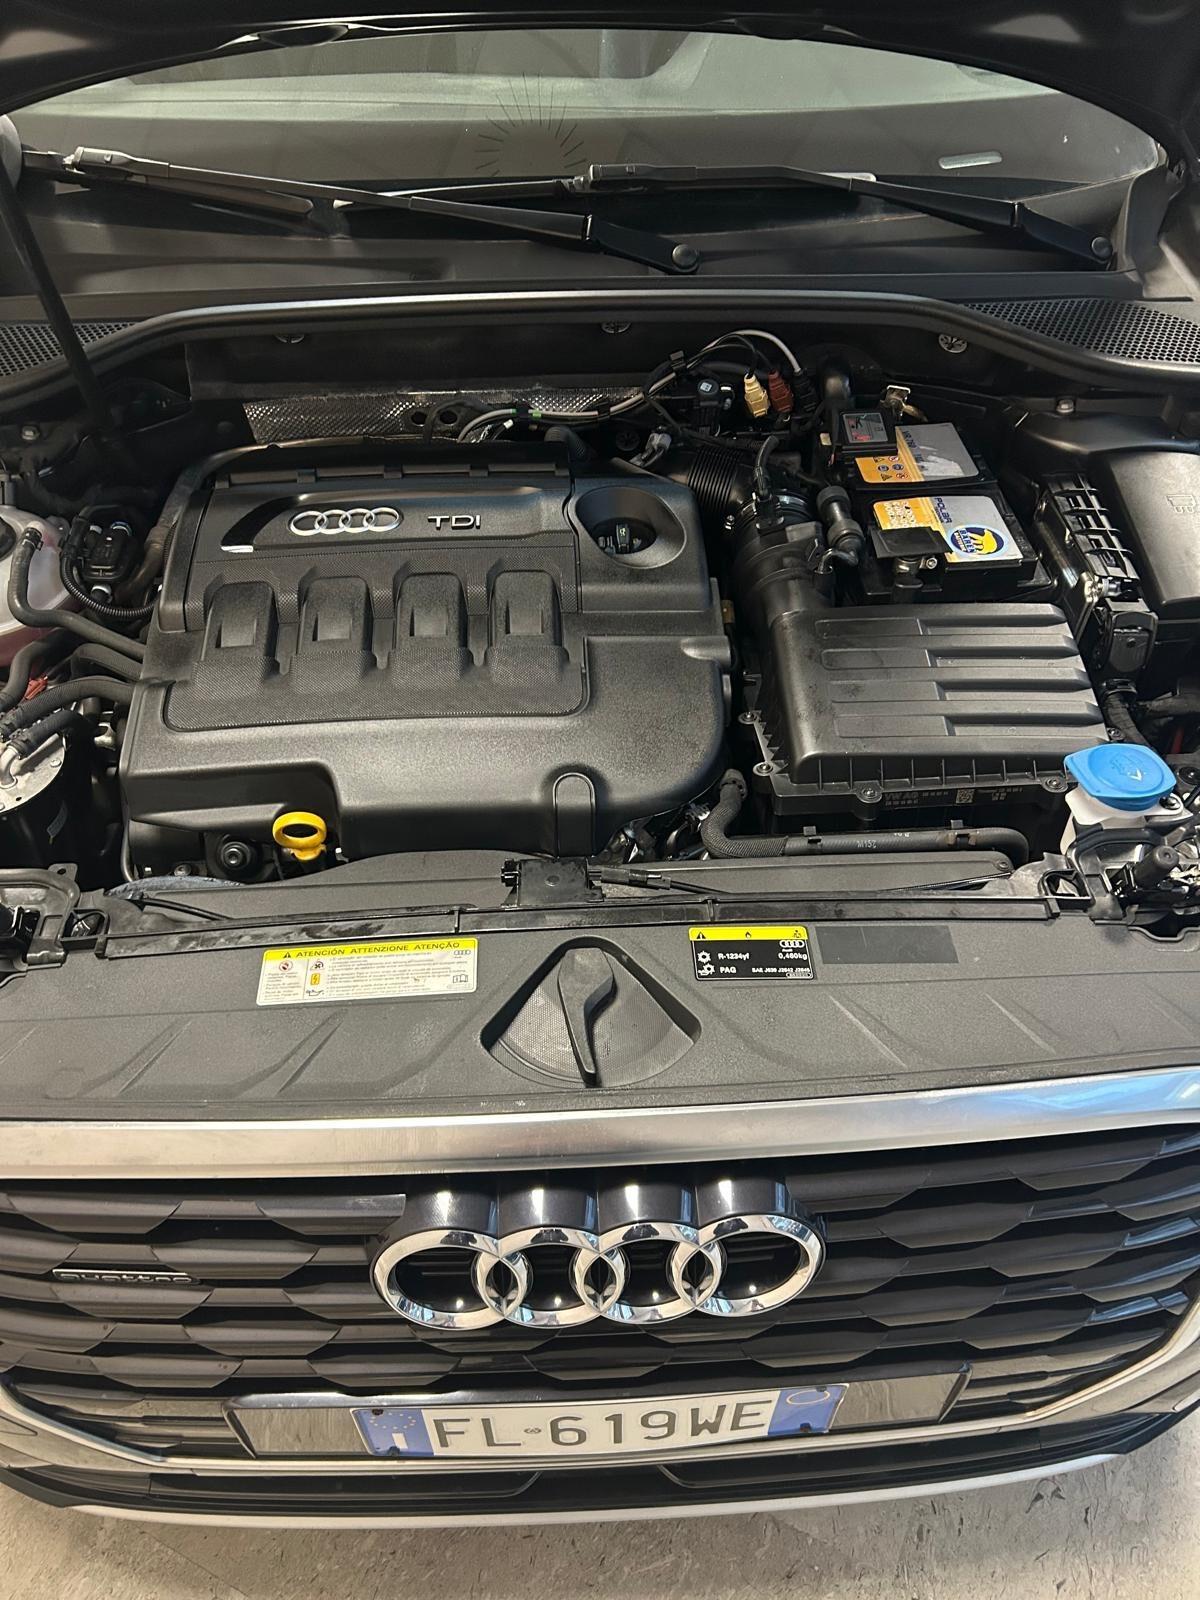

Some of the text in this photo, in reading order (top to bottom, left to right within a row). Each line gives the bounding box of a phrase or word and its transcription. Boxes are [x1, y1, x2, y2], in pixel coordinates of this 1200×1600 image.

[428, 515, 481, 530] TDI
[296, 941, 460, 958] ATENCIÓN ATTENZIONE ATENÇÃO
[717, 952, 750, 961] R-1234yf
[719, 966, 737, 974] PAG
[432, 1399, 773, 1448] FL 619WE
